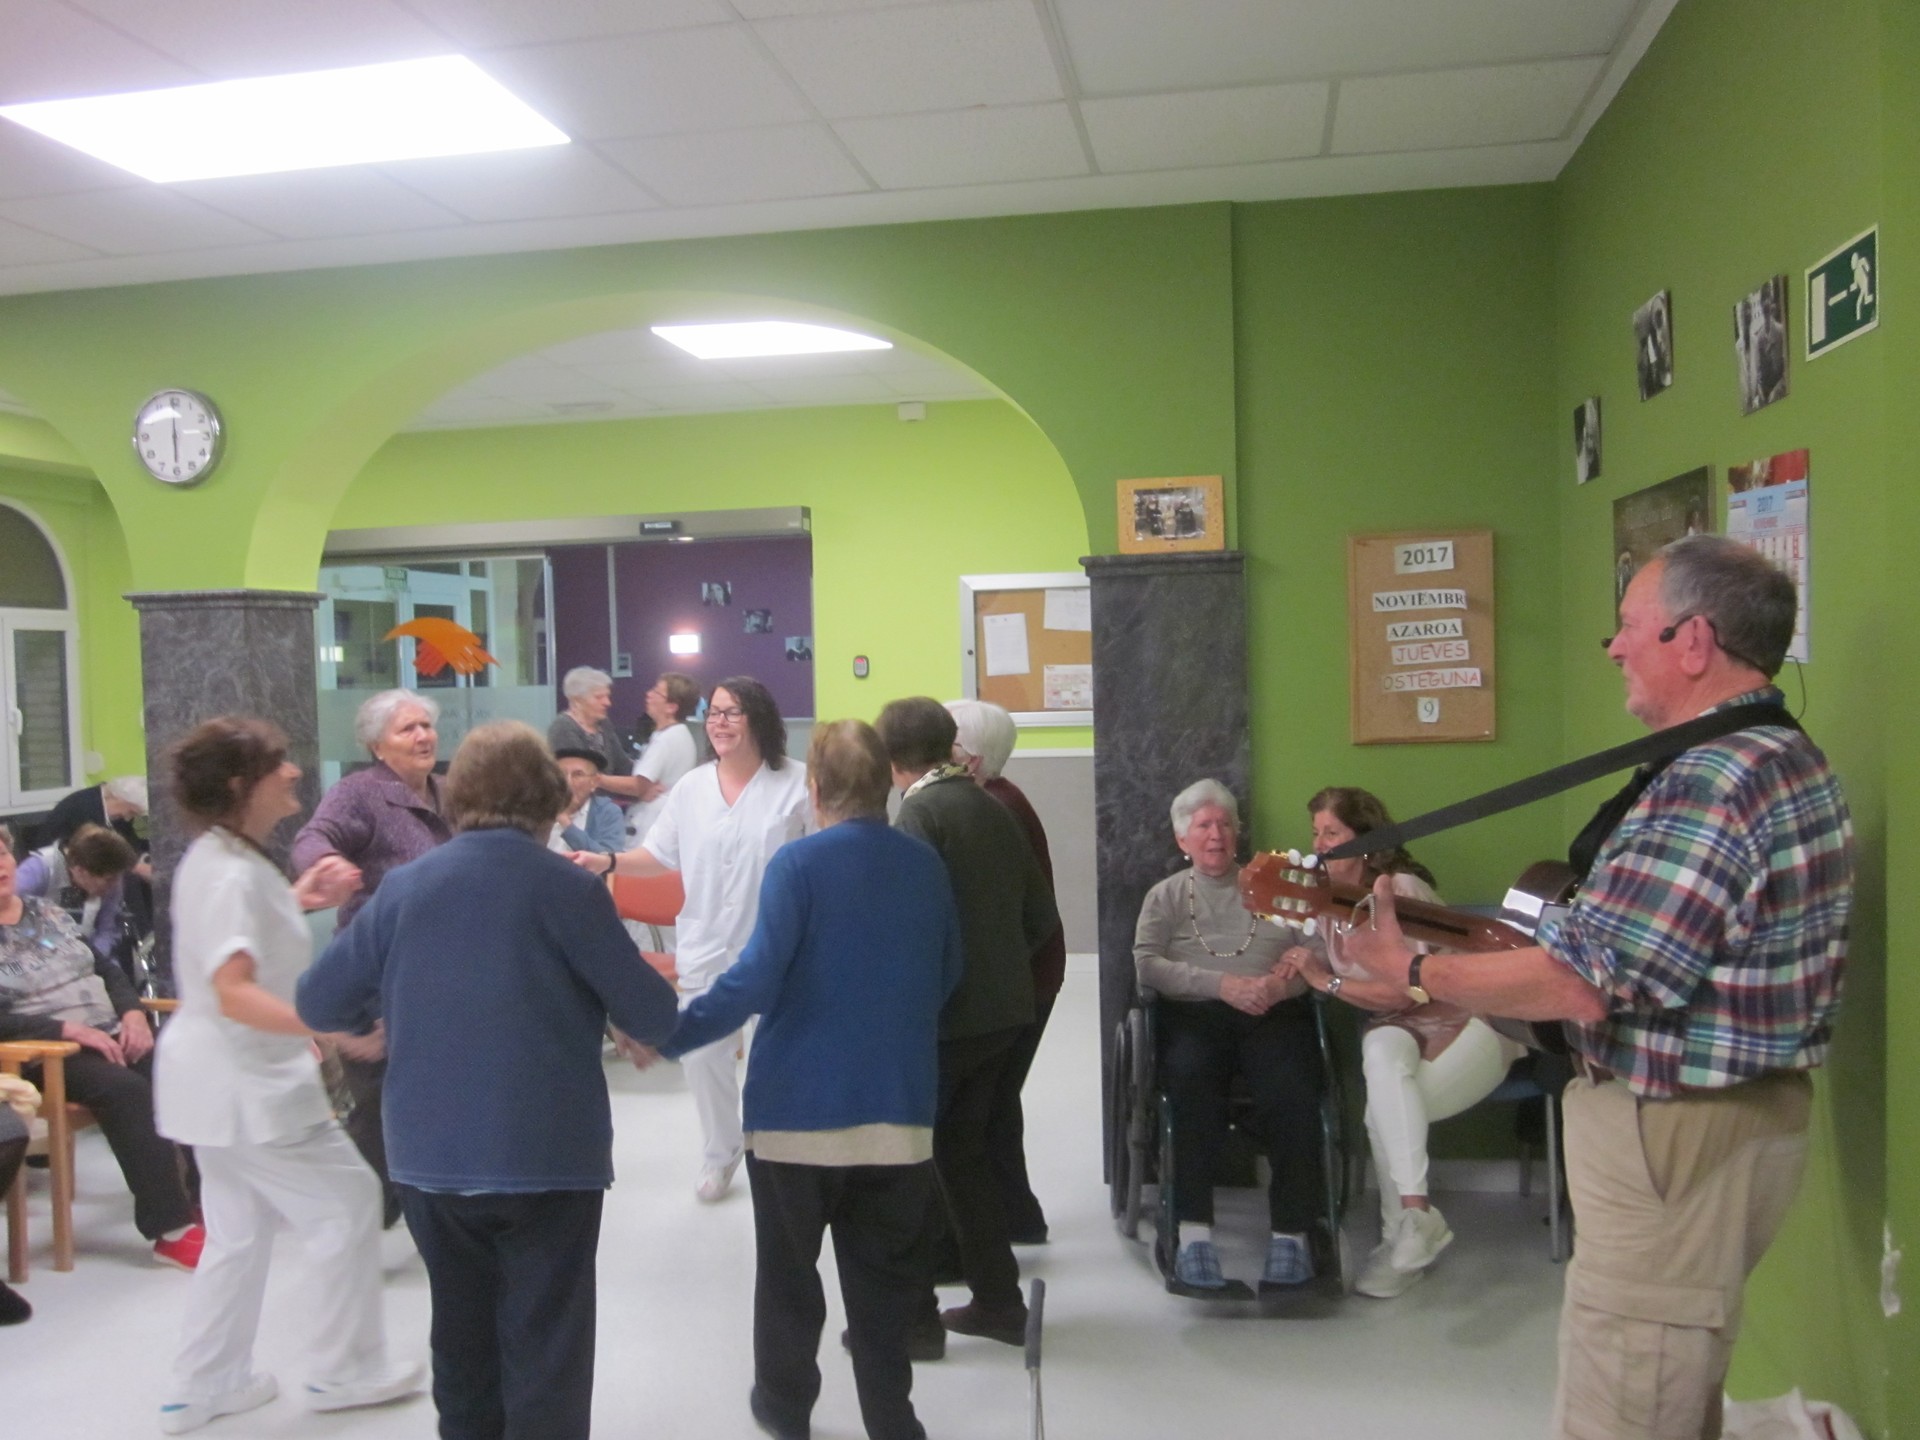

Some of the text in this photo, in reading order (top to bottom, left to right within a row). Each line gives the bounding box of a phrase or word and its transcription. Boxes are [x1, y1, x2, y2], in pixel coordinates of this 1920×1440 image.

[198, 413, 205, 424] 2
[141, 433, 150, 442] 9
[202, 431, 211, 441] 3
[146, 449, 156, 459] 8
[199, 447, 206, 458] 4
[158, 462, 165, 471] 7
[173, 466, 181, 476] 6
[188, 461, 196, 471] 5
[1403, 546, 1449, 567] 2017
[1375, 592, 1466, 608] NOVIEMBR
[1388, 622, 1459, 638] AZAROA
[1395, 643, 1466, 663] JUEVES
[1383, 671, 1479, 690] OSTEGUNA
[1424, 701, 1434, 718] 9
